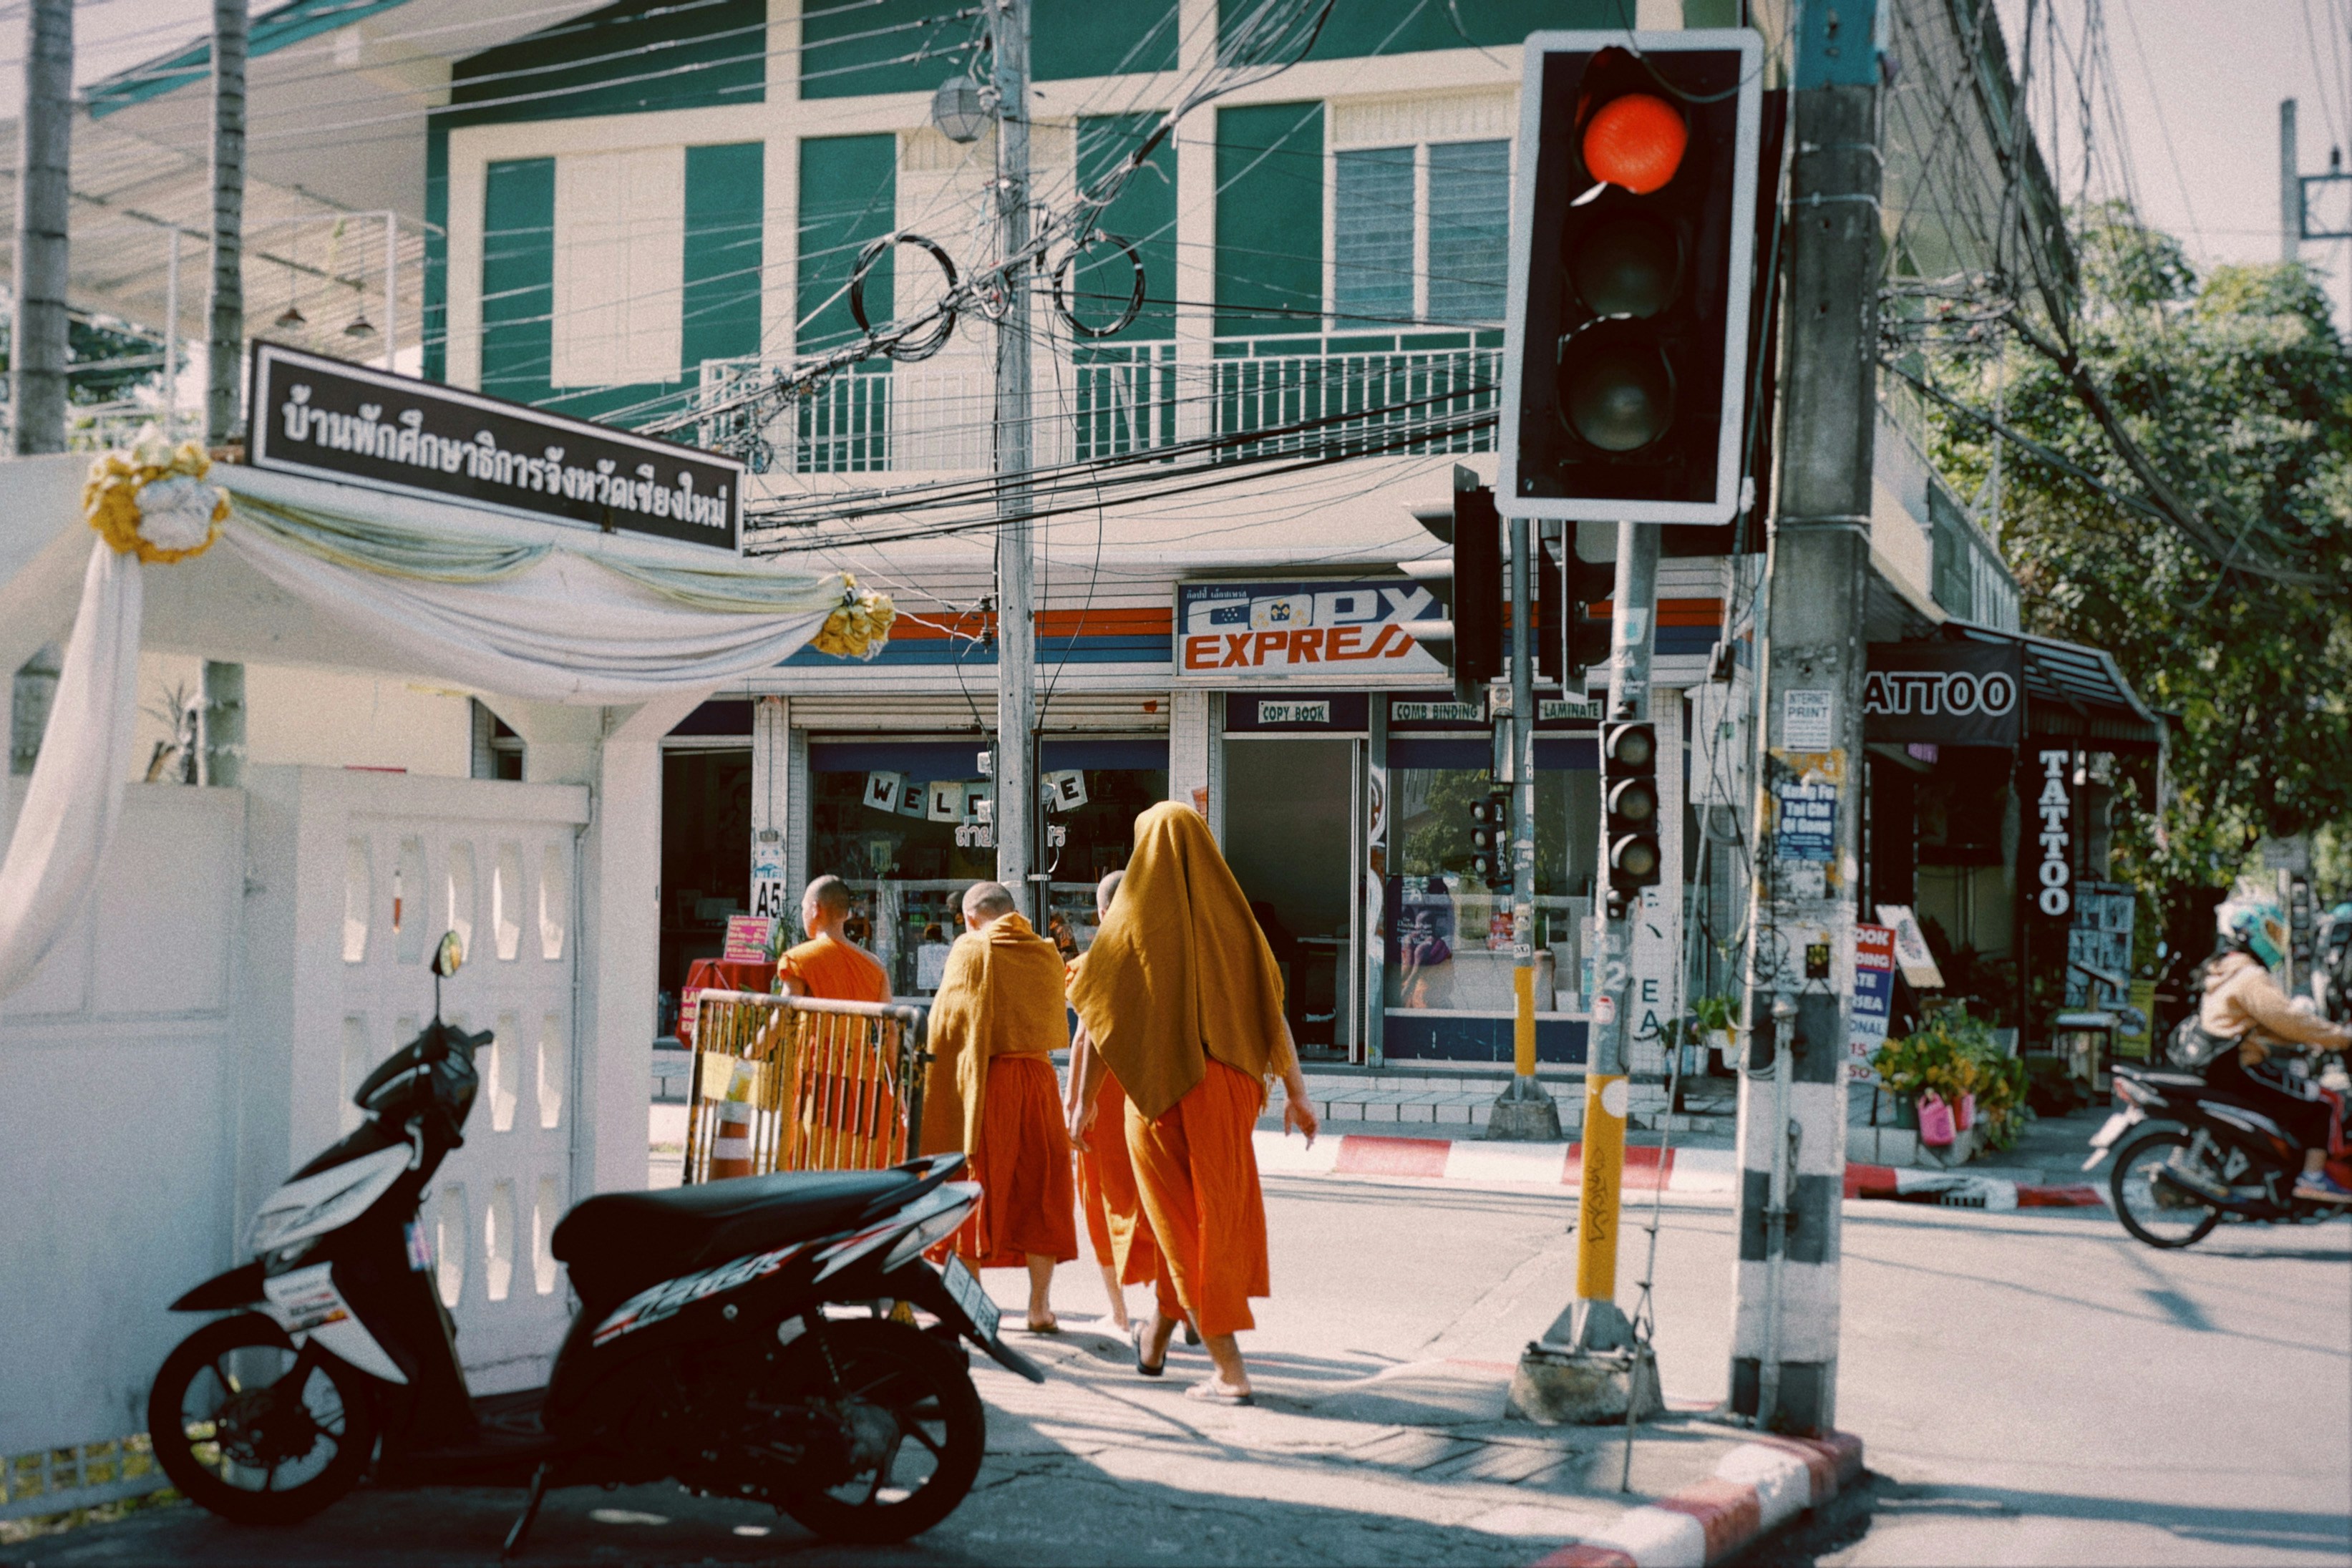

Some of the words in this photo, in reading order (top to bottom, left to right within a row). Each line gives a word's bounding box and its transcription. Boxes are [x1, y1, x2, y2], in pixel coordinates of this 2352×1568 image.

[281, 384, 727, 530] บ้านพักศึกษาธิการจังหวัดเชียงใหม่
[1187, 585, 1434, 635] COPY
[1543, 702, 1598, 717] LAMINATE
[1862, 671, 2017, 716] ATTOO
[1263, 705, 1289, 721] COPY
[1295, 705, 1324, 721] BOOK
[1396, 704, 1427, 720] COMB
[1432, 704, 1478, 719] BINDING
[1788, 706, 1829, 717] PRINT
[2038, 750, 2070, 915] TATTOO
[757, 882, 781, 917] A5
